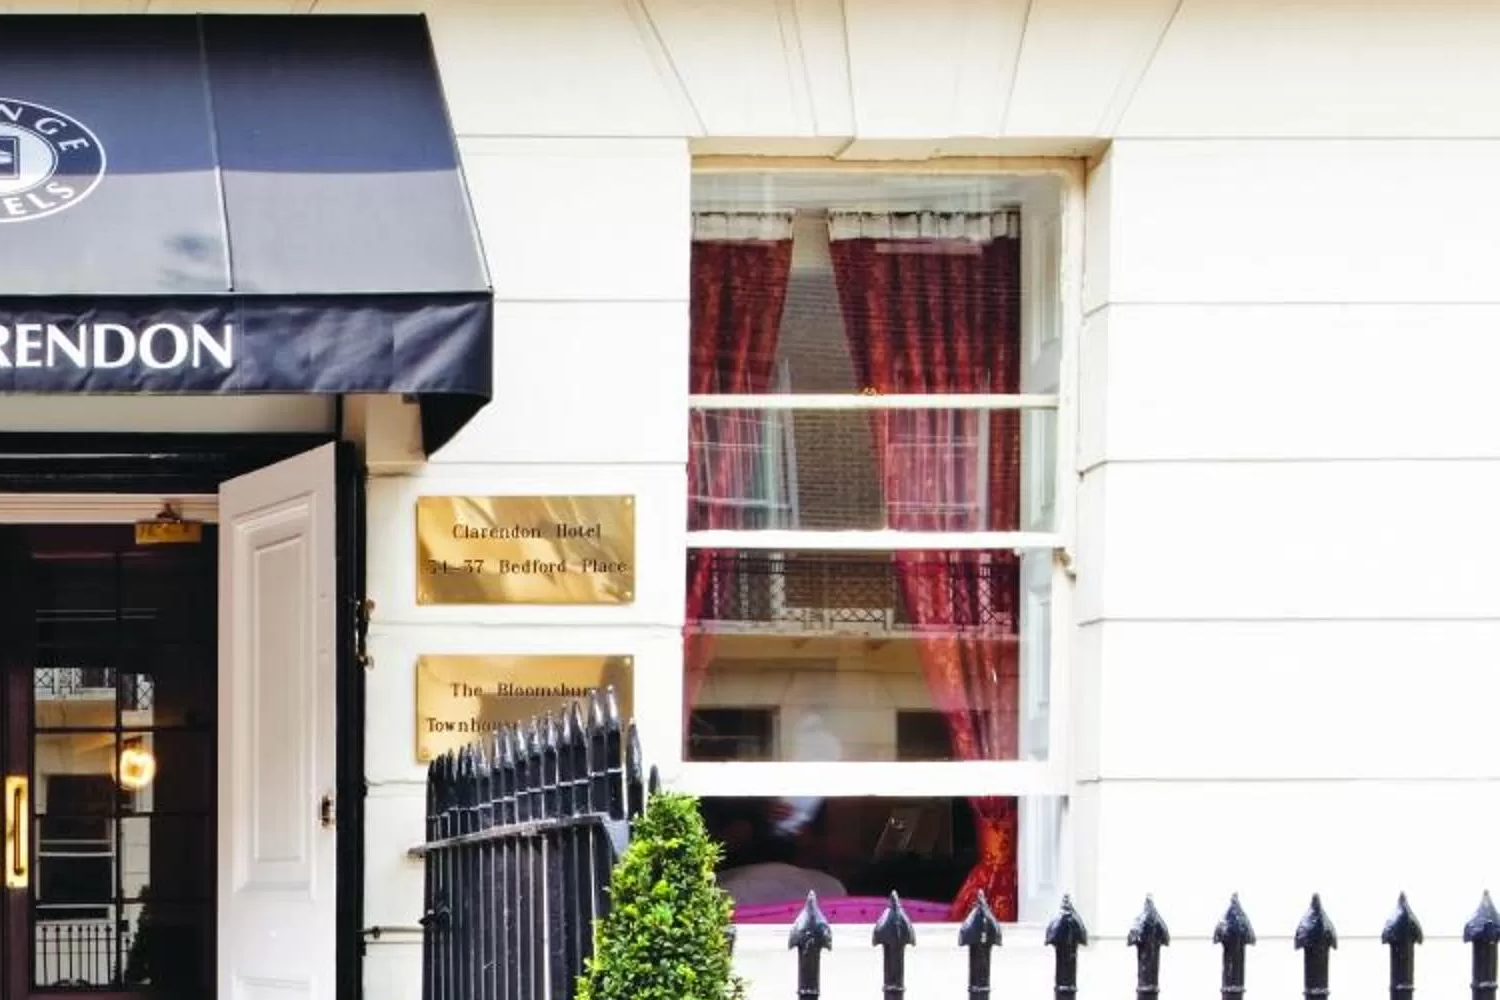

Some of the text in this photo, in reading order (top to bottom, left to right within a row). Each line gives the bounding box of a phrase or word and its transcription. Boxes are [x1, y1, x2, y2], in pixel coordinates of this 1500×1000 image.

[452, 523, 601, 539] Clarendon Hotel
[499, 559, 566, 575] Bedford
[581, 559, 628, 574] Place
[451, 682, 483, 698] The
